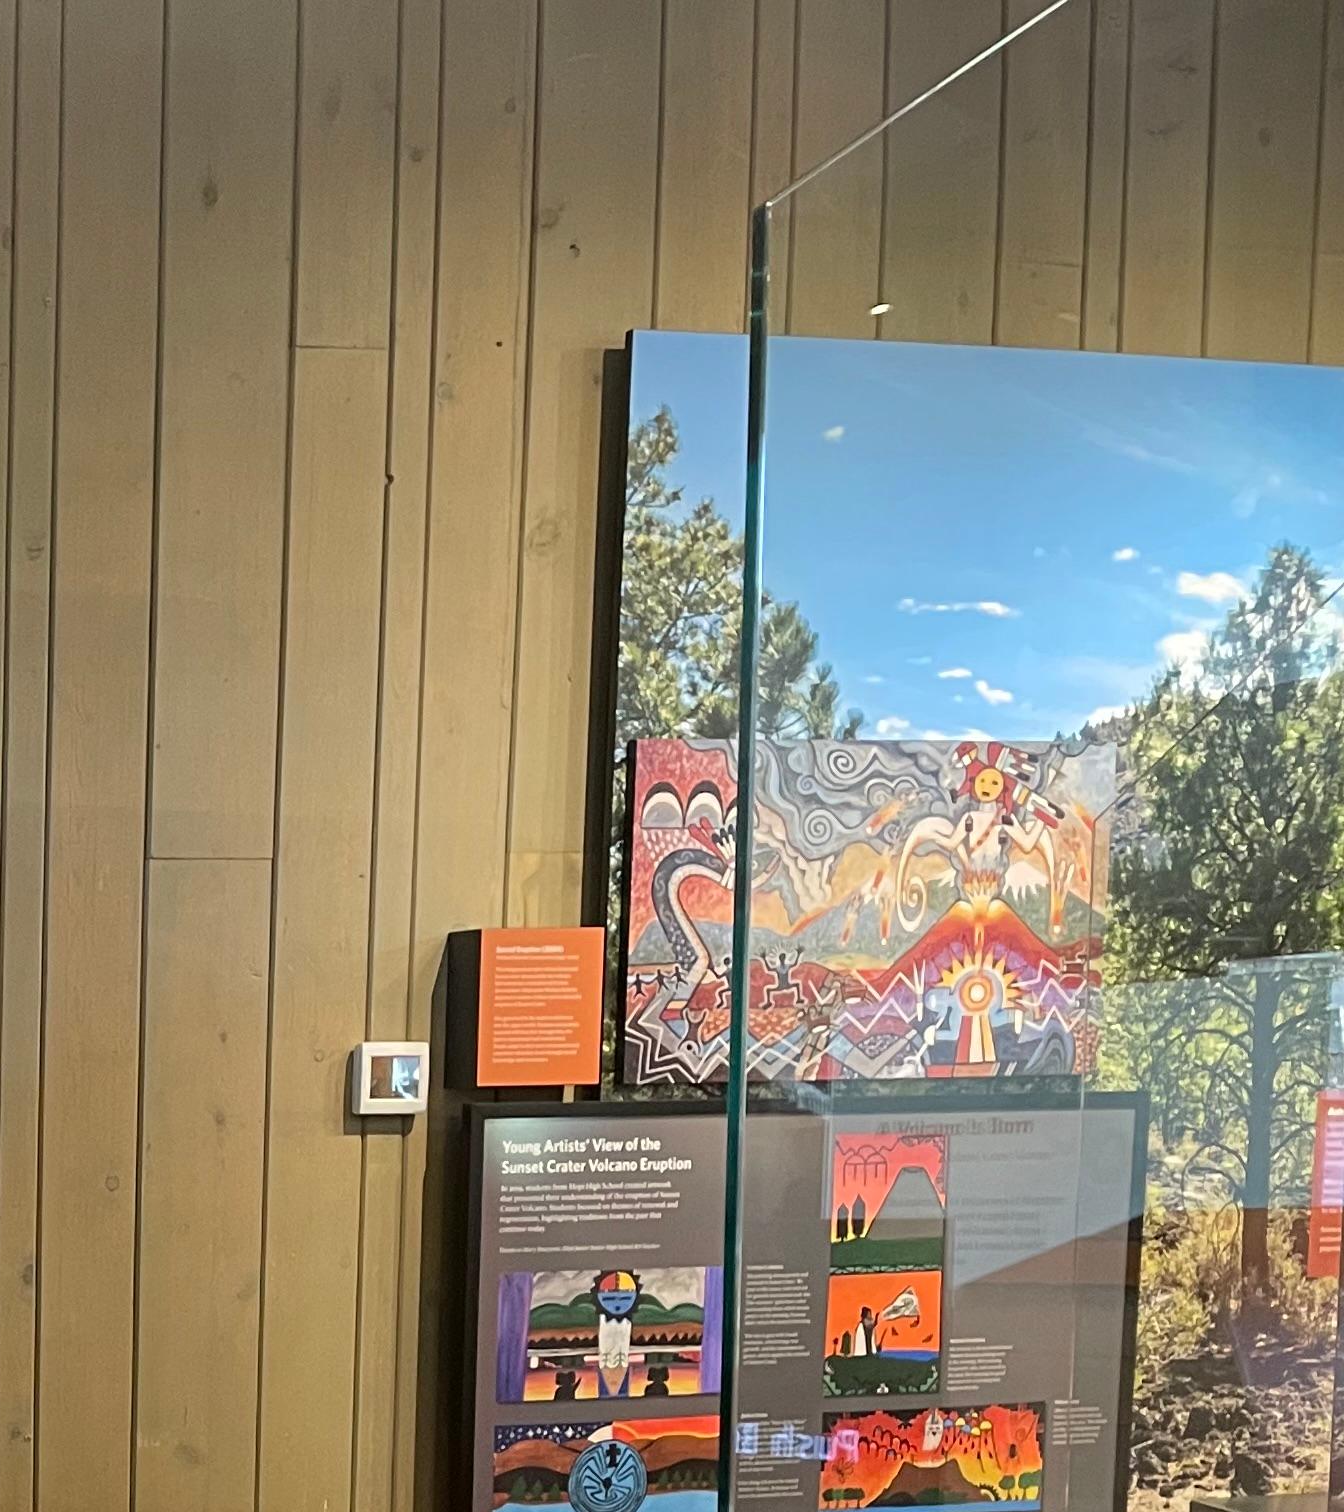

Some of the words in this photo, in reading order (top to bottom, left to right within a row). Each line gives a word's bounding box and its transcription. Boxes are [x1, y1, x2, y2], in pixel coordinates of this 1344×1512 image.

[502, 1141, 541, 1155] Young
[544, 1138, 590, 1153] Artists'
[592, 1138, 624, 1152] View
[625, 1137, 638, 1151] of
[641, 1137, 661, 1151] the
[501, 1160, 544, 1174] Sunset
[547, 1160, 586, 1174] Crater
[588, 1159, 637, 1172] Volcano
[640, 1157, 692, 1173] Eruption
